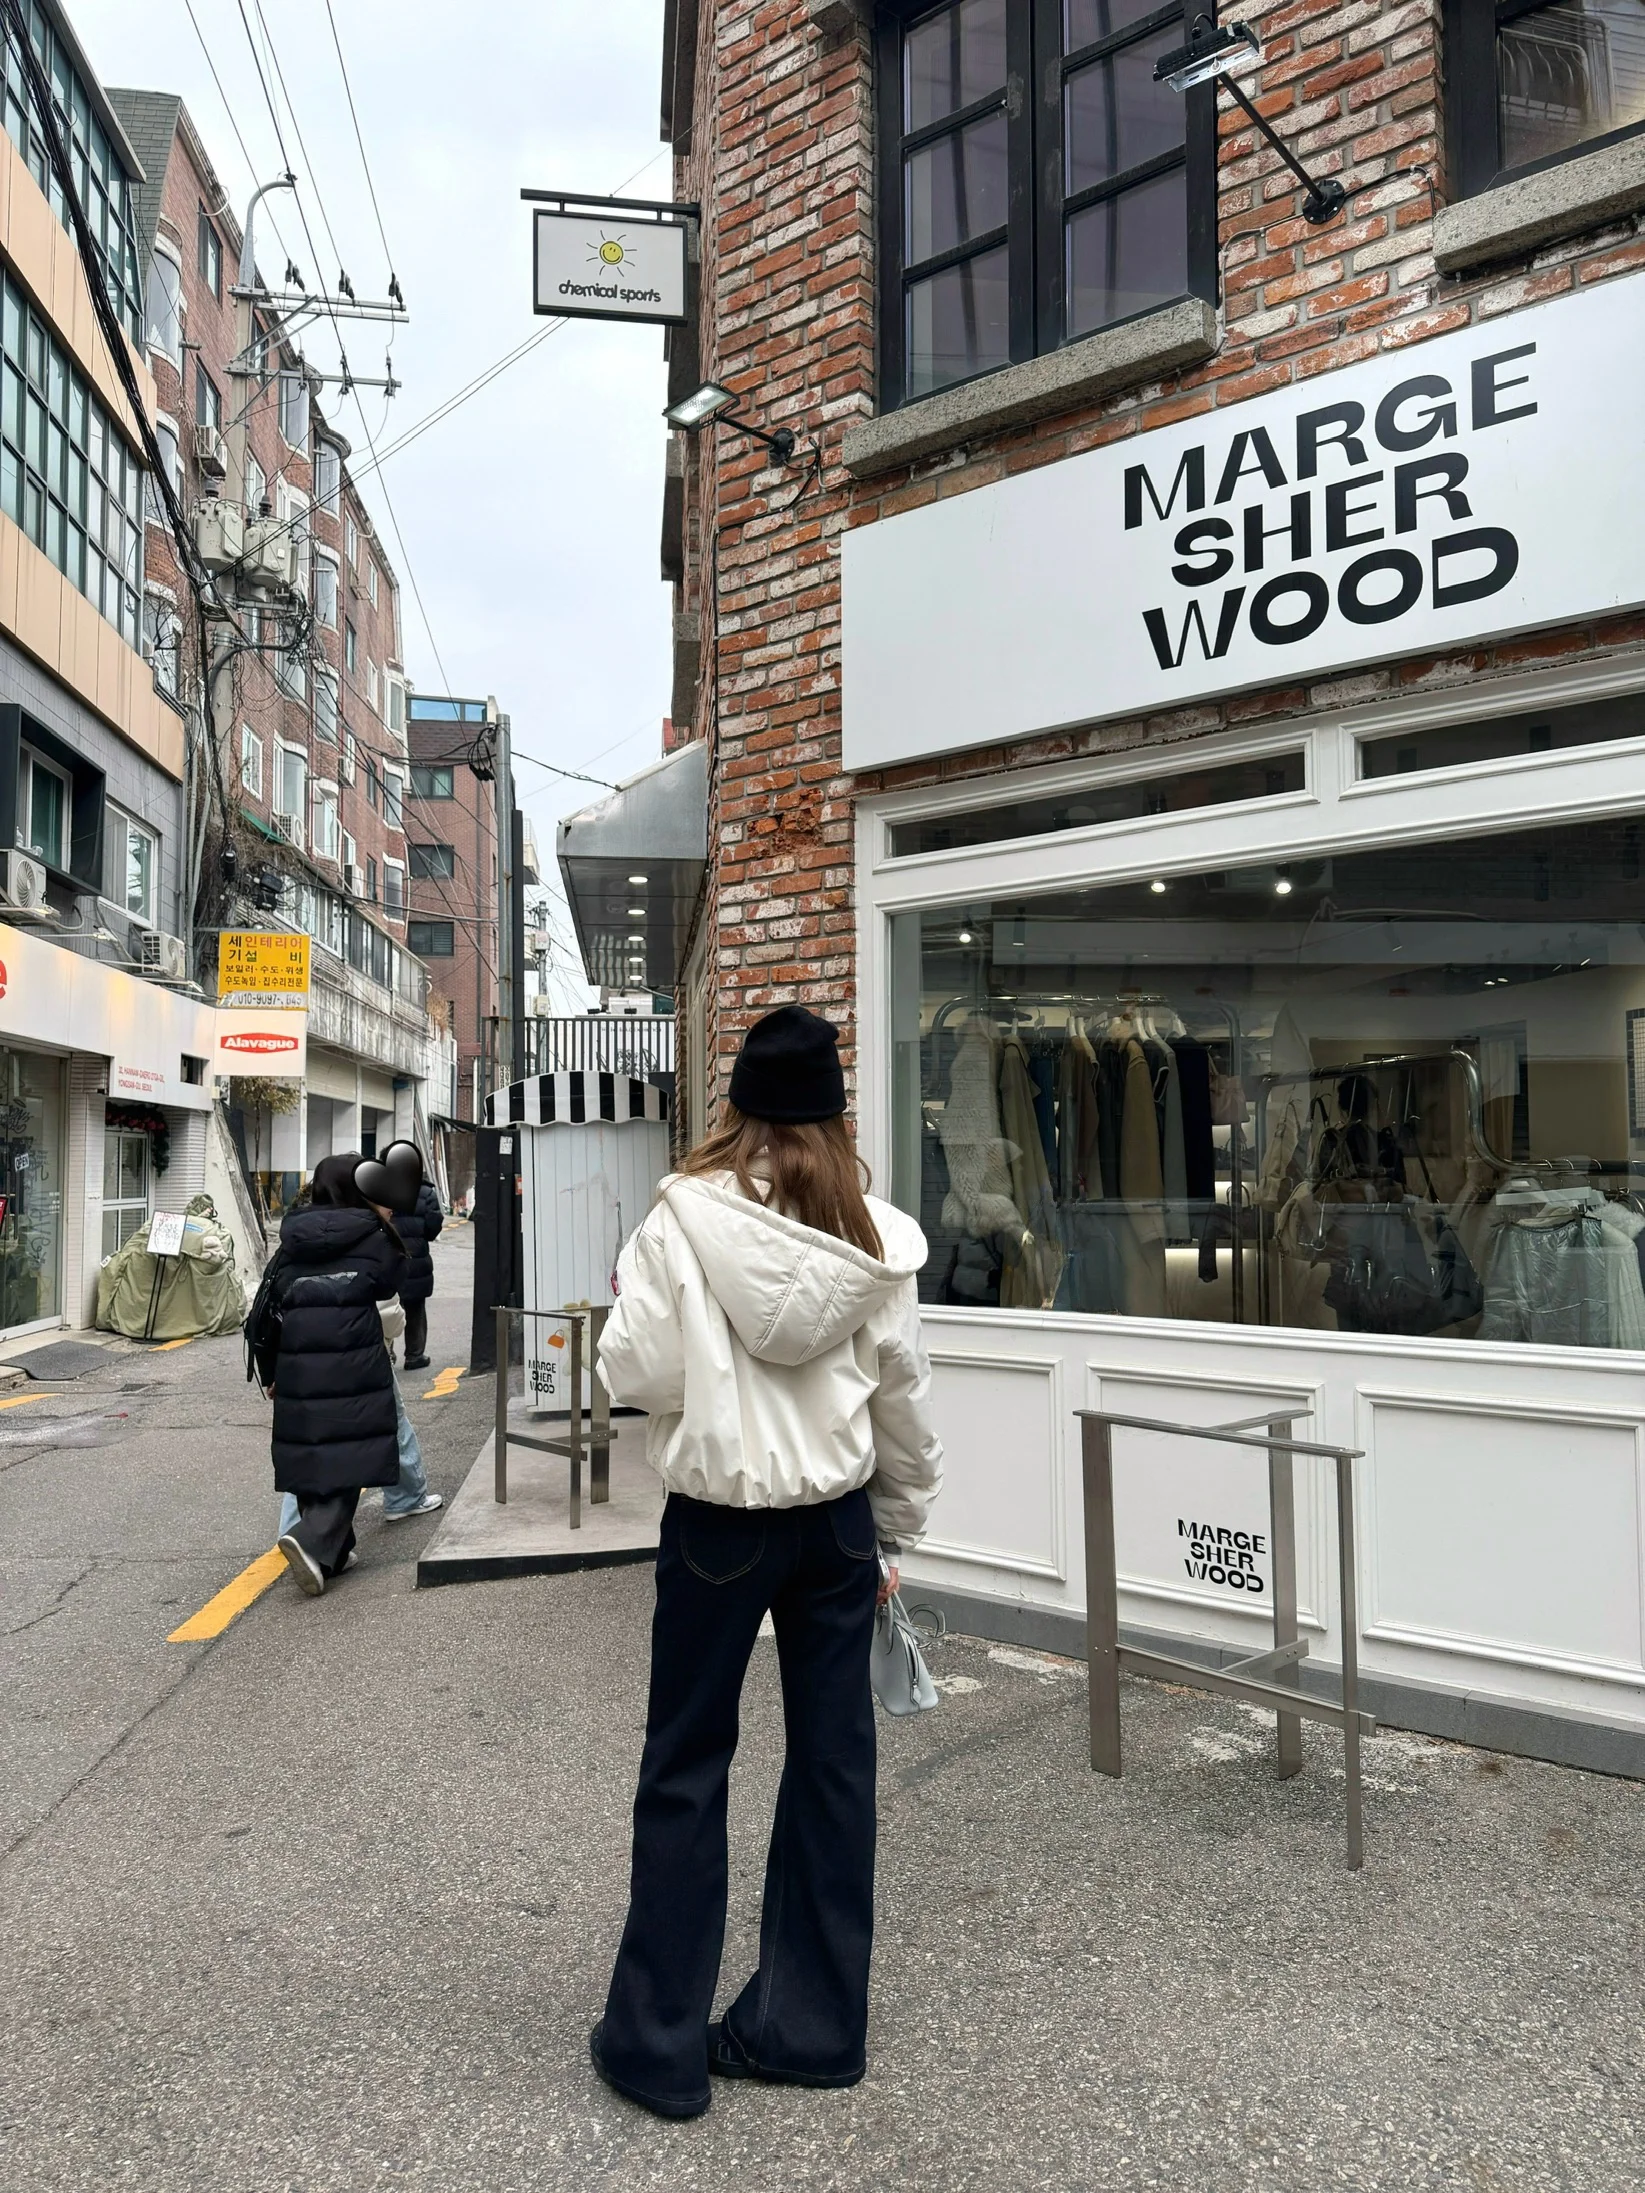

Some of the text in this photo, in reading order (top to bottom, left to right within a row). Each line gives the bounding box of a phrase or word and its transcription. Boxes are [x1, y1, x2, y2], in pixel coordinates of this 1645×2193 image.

[558, 280, 661, 303] chemical sports
[1124, 342, 1538, 530] MARGE
[1171, 452, 1473, 587] SHER
[1142, 527, 1518, 670] WOOD
[224, 1036, 295, 1050] Alavague
[528, 1359, 556, 1373] MARGE
[532, 1370, 552, 1383] SHER
[529, 1380, 555, 1394] WOOD
[1177, 1518, 1266, 1554] MARGE
[1190, 1541, 1255, 1572] SHER
[1184, 1559, 1264, 1593] WOOD
